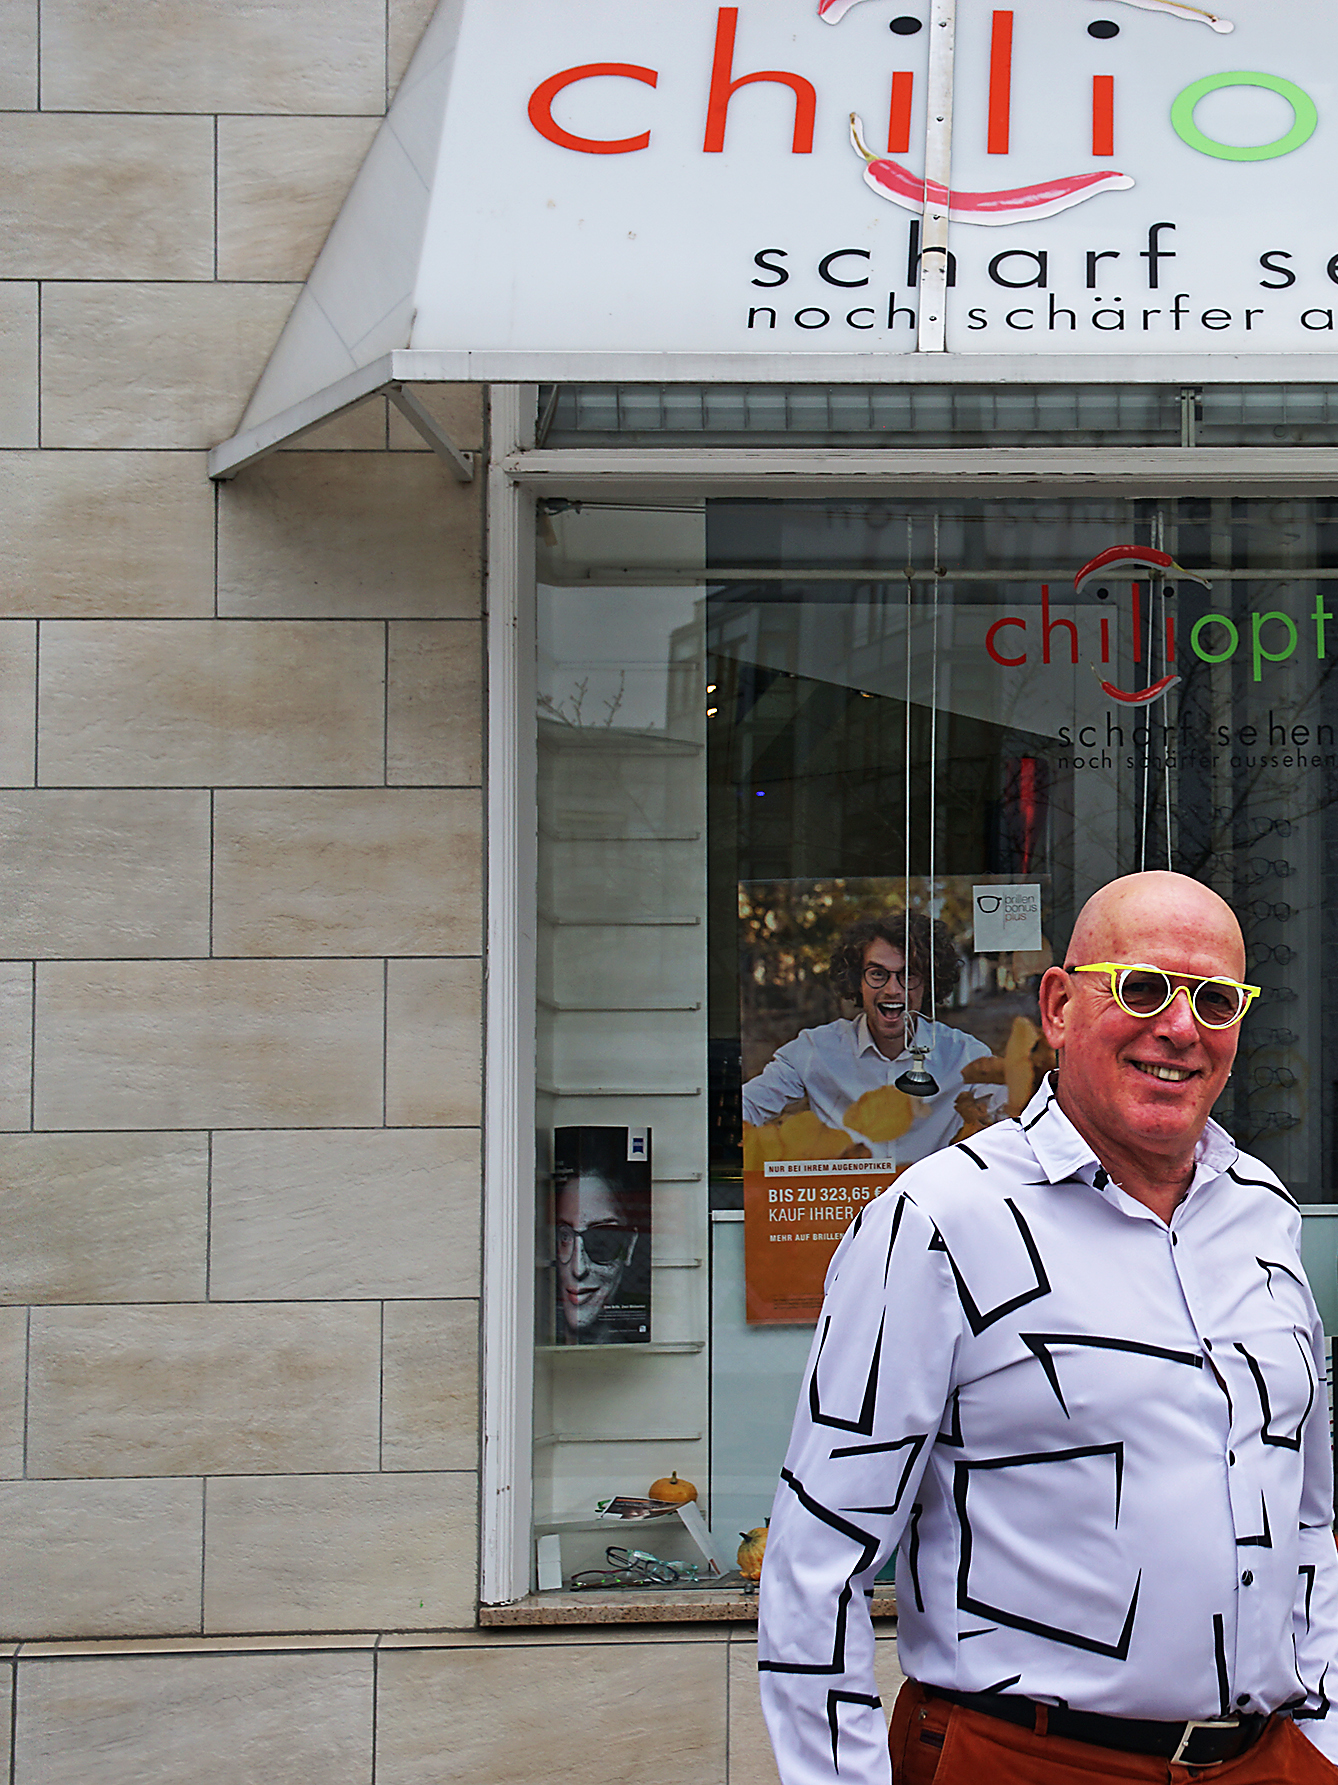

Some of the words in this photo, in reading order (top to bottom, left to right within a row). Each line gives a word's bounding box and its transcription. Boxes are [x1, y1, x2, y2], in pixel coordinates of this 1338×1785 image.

[750, 219, 1177, 289] scharf
[747, 292, 916, 330] noch
[966, 293, 1264, 331] schärfer
[1057, 709, 1192, 748] scharf
[1217, 709, 1335, 747] sehen
[1058, 748, 1112, 769] noch
[1126, 748, 1220, 769] schärfer
[1230, 747, 1336, 768] aussehen
[1004, 894, 1035, 904] brillen
[1004, 903, 1038, 913] bonus
[1004, 912, 1028, 923] plus
[768, 1165, 785, 1173] NUR
[788, 1165, 801, 1173] BEI
[804, 1164, 830, 1172] IHREM
[832, 1162, 892, 1172] AUGENOPTIKER
[768, 1188, 794, 1203] BIS
[797, 1188, 816, 1202] ZU
[820, 1187, 870, 1203] 323,65
[769, 1207, 805, 1222] KAUF
[810, 1206, 854, 1221] IHRER
[769, 1233, 793, 1242] MEHR
[795, 1233, 810, 1241] AUF
